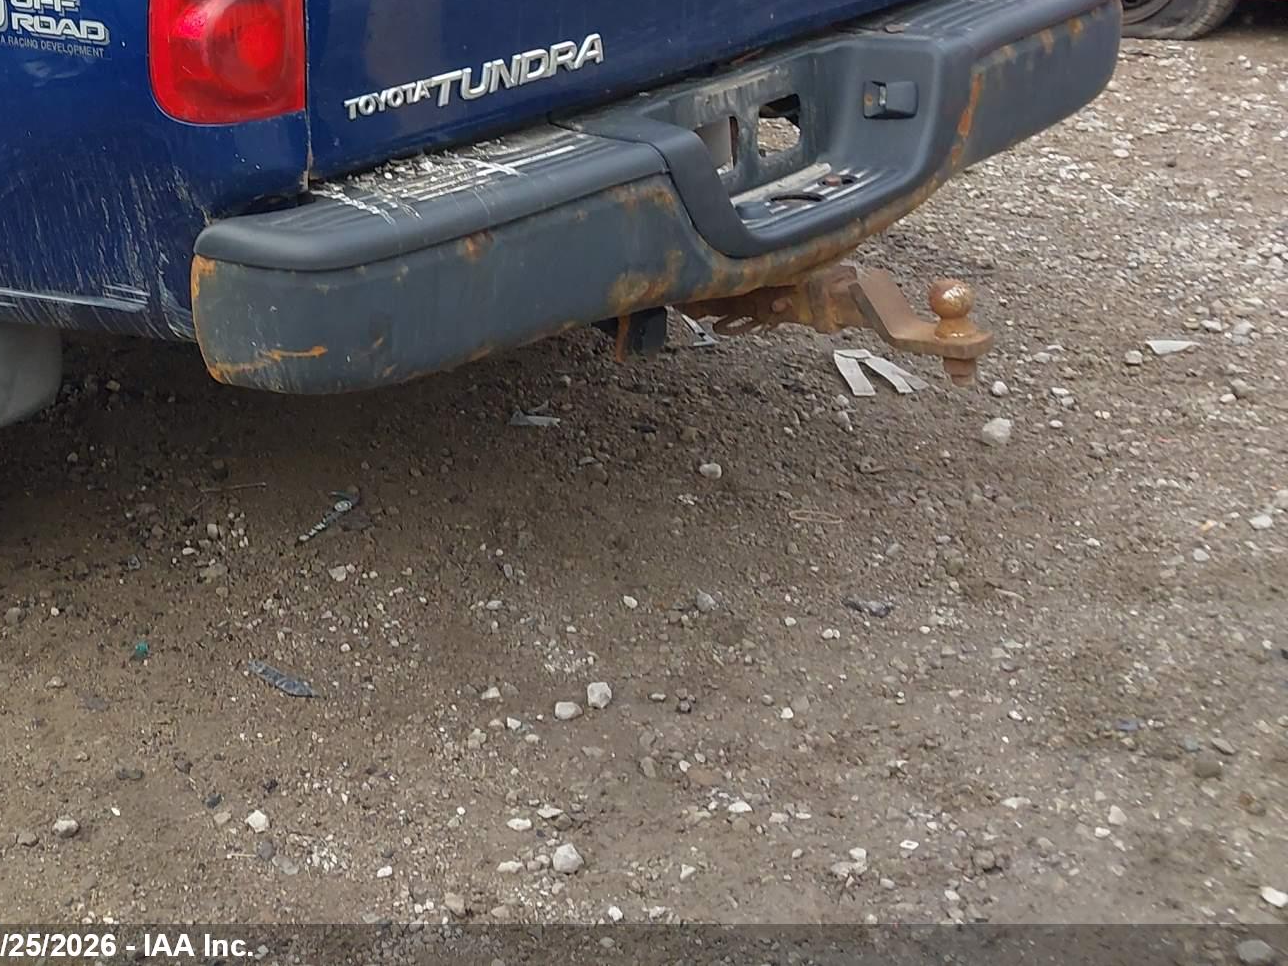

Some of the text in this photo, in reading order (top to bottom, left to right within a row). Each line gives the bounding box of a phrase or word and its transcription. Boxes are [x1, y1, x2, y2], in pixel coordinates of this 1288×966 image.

[11, 11, 110, 45] ROAD
[8, 35, 39, 50] RACING
[40, 40, 106, 58] DEVELOPMENT
[344, 33, 605, 120] TOYOTA TUNDRA
